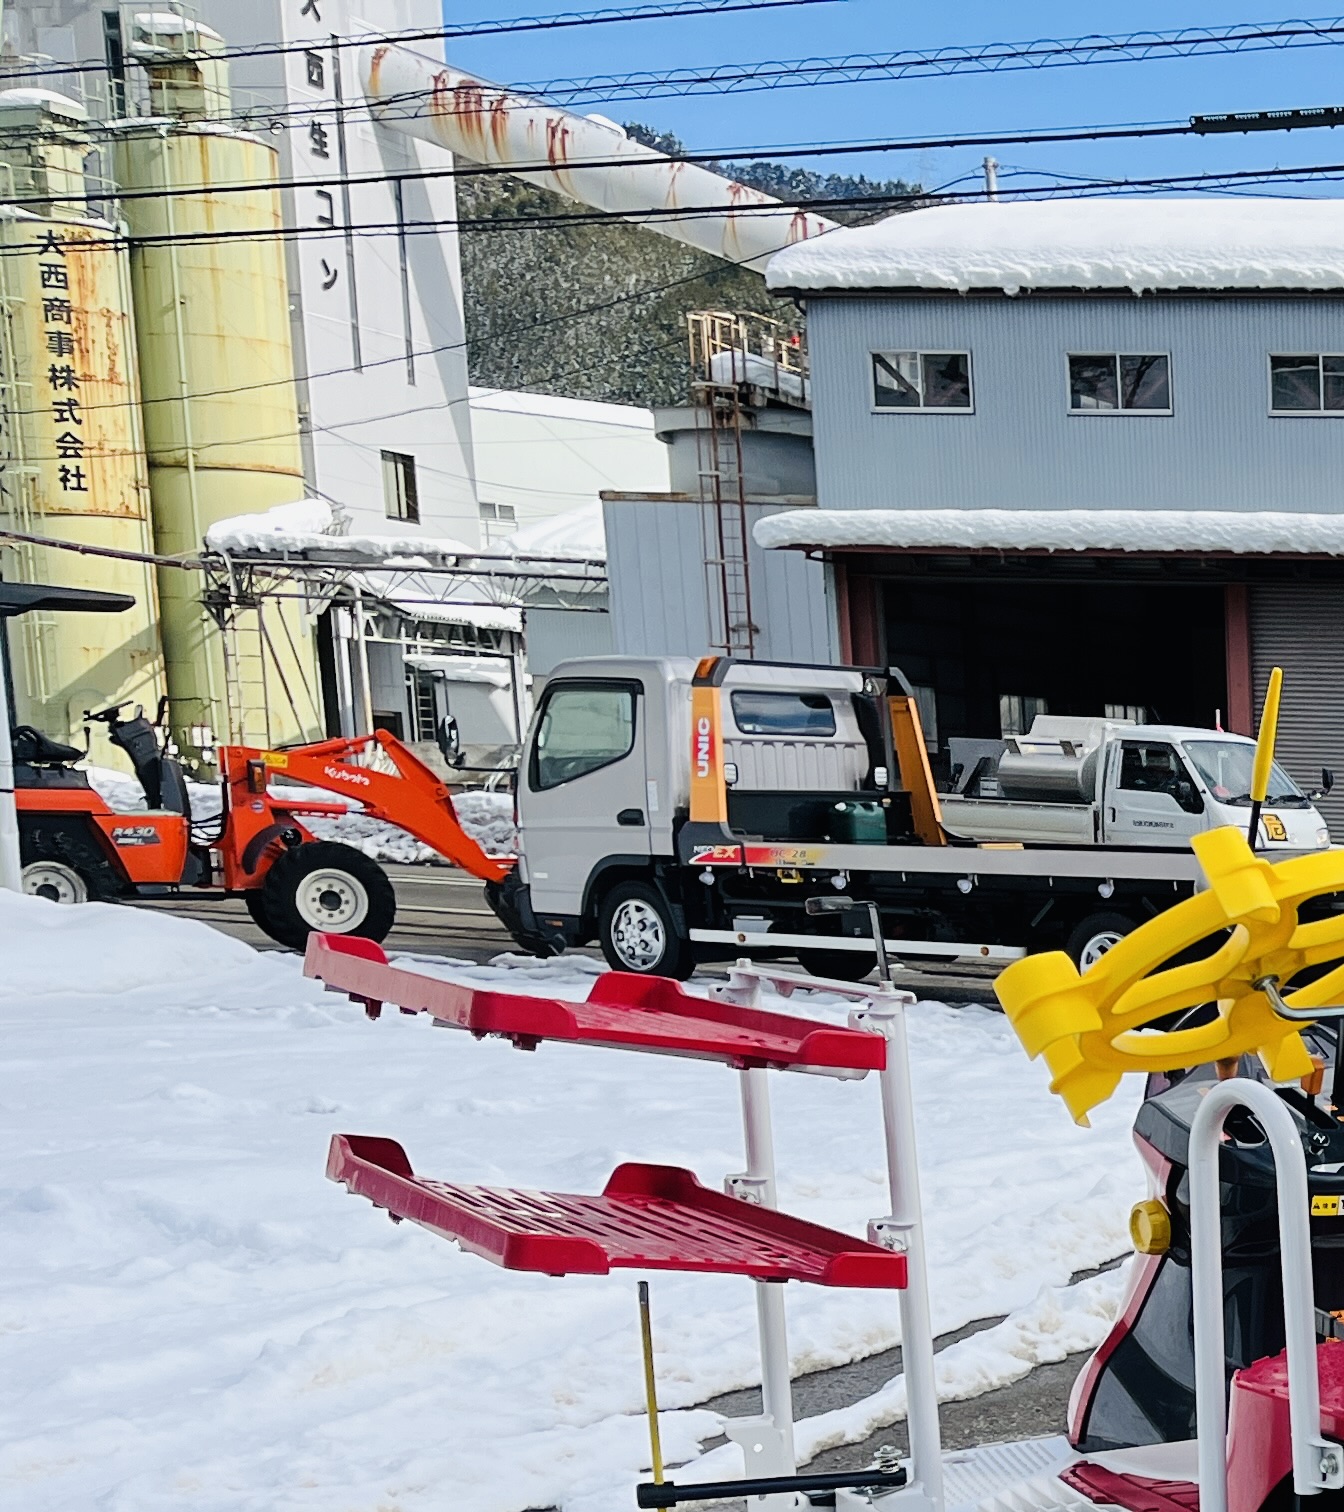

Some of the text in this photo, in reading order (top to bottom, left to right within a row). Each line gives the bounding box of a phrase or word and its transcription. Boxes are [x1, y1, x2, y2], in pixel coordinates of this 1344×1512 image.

[37, 229, 88, 492] 大西商事株式会社
[698, 717, 711, 778] UNIC
[324, 766, 370, 786] Kubota
[112, 826, 156, 838] R430
[713, 845, 736, 859] EX
